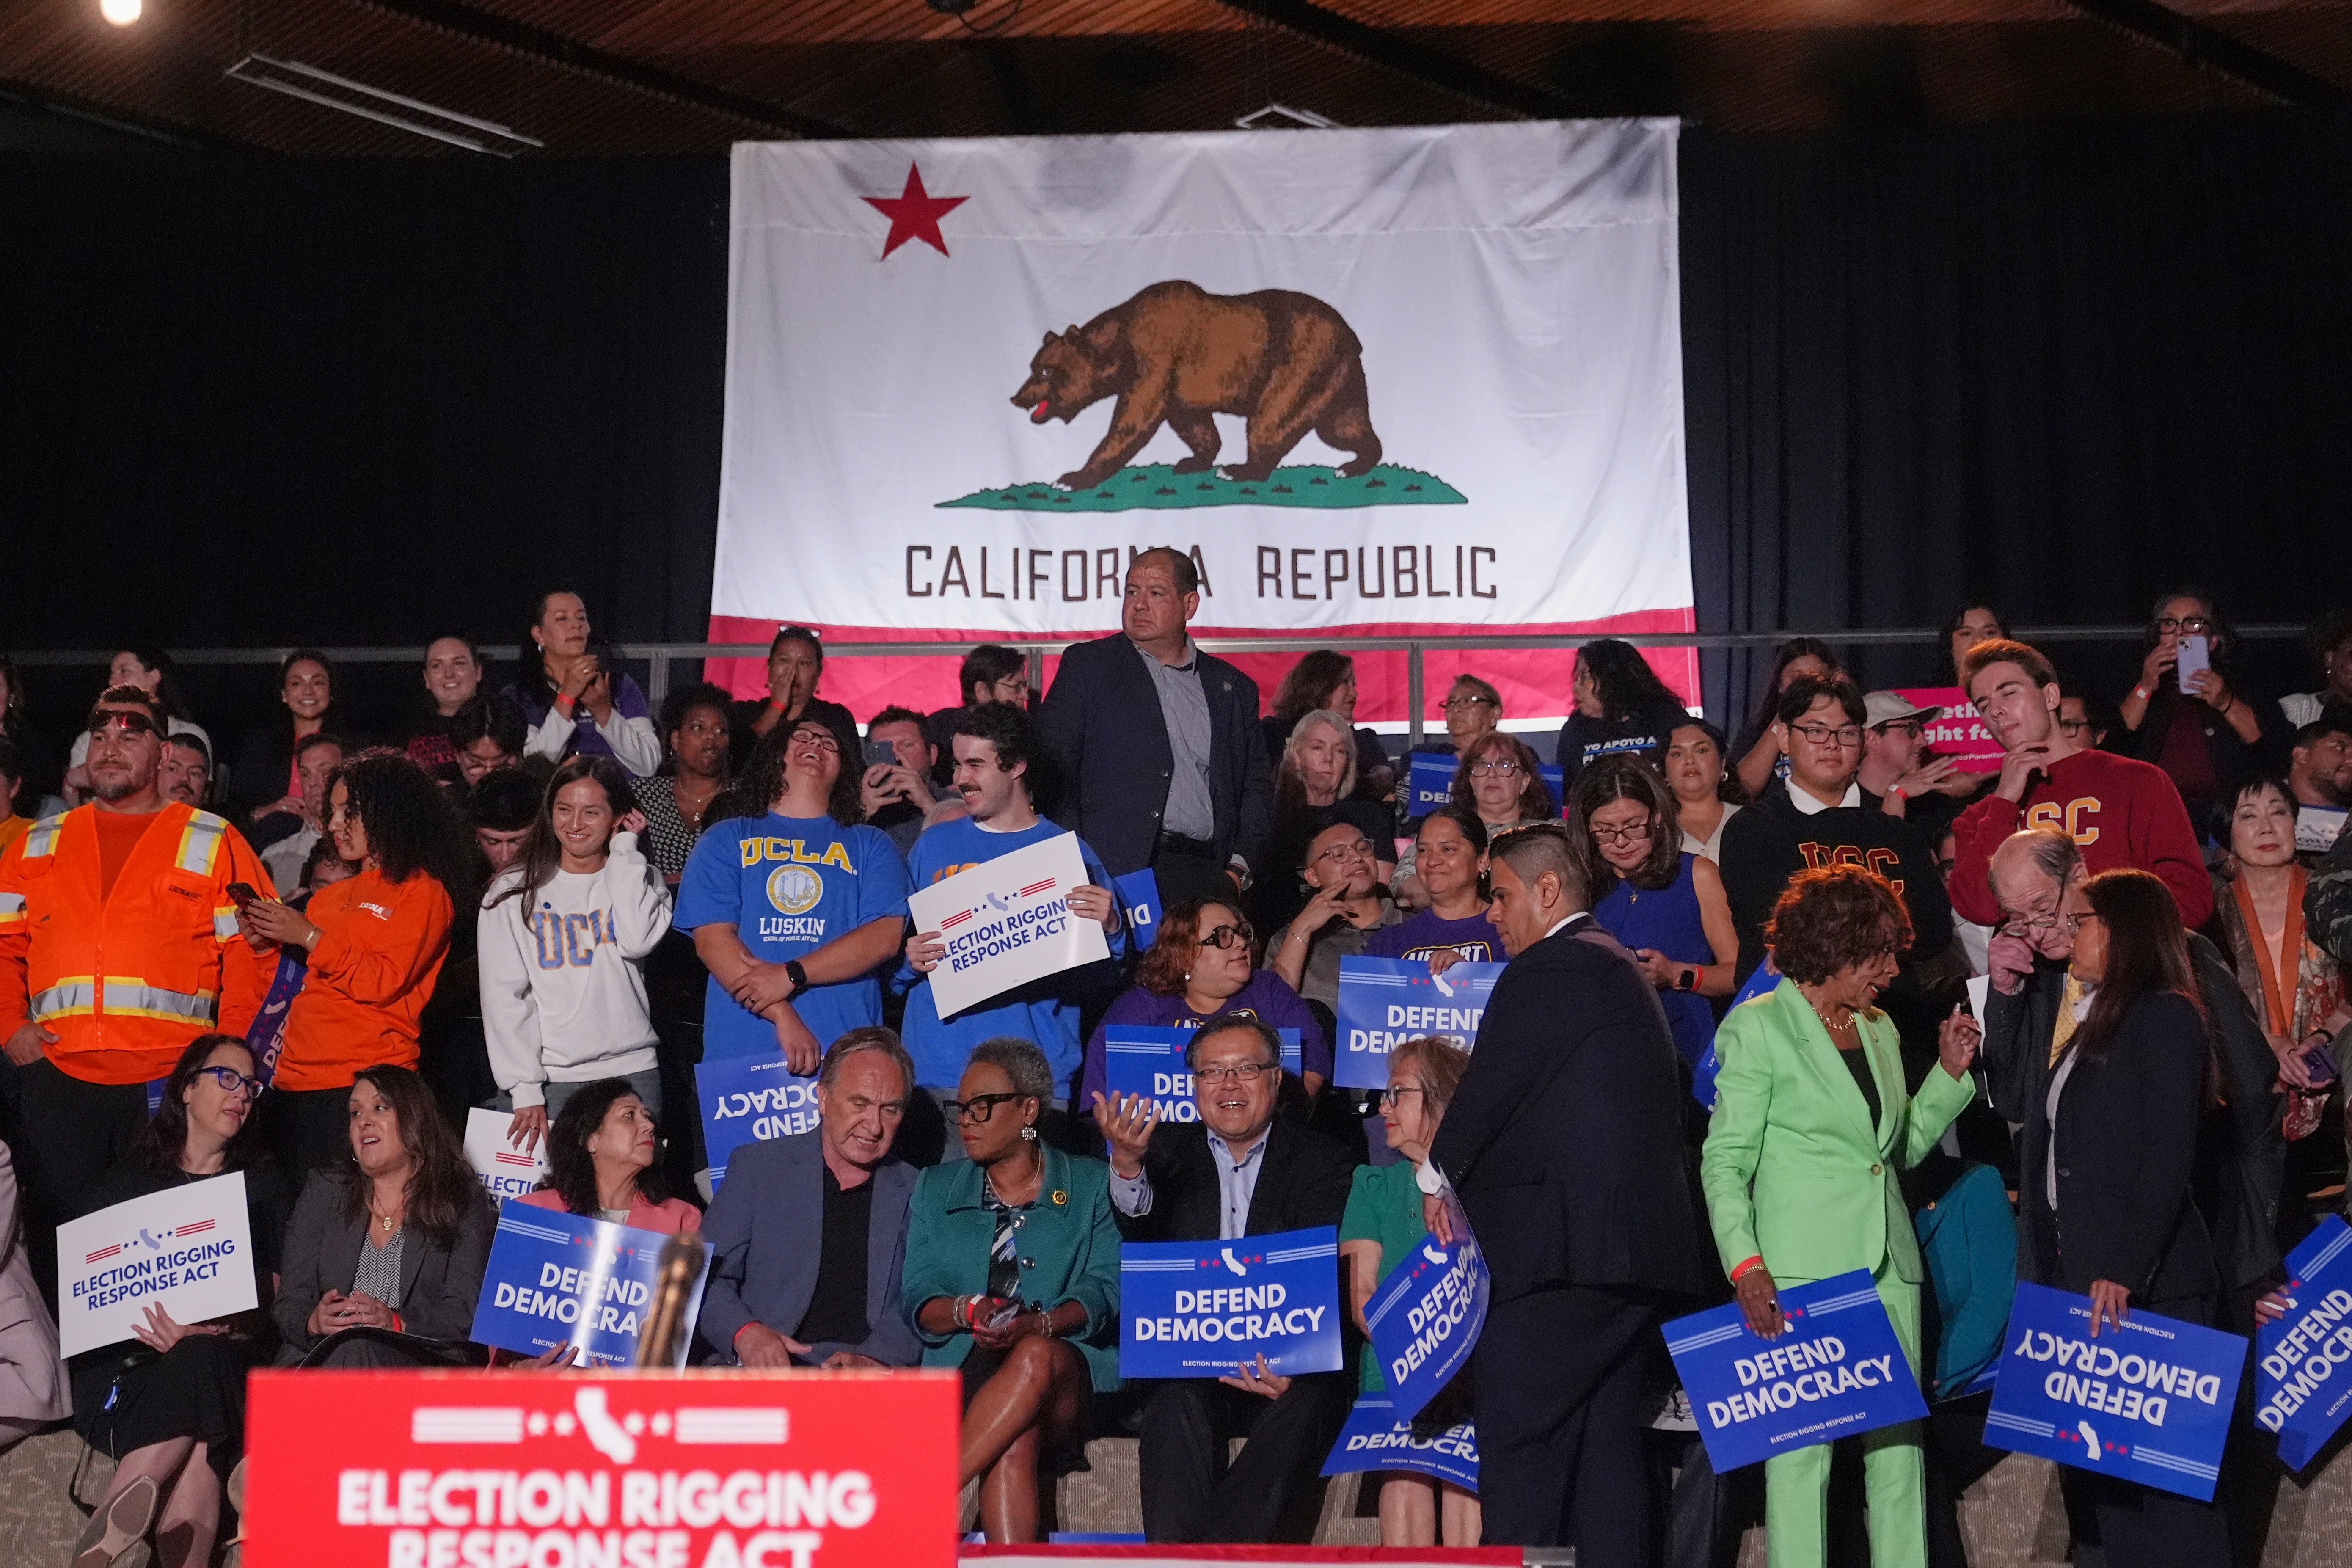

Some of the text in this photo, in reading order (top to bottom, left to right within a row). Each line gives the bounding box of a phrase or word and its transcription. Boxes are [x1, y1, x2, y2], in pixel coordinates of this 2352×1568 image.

[906, 545, 1497, 601] CALIFORA REPUBLIC
[1584, 736, 1657, 752] YO APOYO A
[2017, 796, 2101, 845] SC
[740, 836, 853, 875] UCLA
[759, 917, 826, 936] LUSKIN
[937, 921, 1004, 962] LECTION
[952, 916, 1066, 973] RESPONSE ACT
[713, 1081, 819, 1120] OCRACY
[752, 1109, 821, 1141] FEND
[475, 1173, 540, 1194] LECTI
[73, 1239, 234, 1298] ELECTION RIGGING
[88, 1261, 219, 1311] RESPONSE ACT
[494, 1282, 638, 1337] DEMOCRA
[1176, 1284, 1286, 1314] DEFEND
[1407, 1246, 1467, 1334] DEFEND
[1135, 1306, 1325, 1342] DEMOCRACY
[2119, 1319, 2143, 1331] RIGGIN
[2144, 1326, 2175, 1340] ELECTION
[2260, 1290, 2352, 1382] DEFEND
[587, 1350, 614, 1361] RESPONSE
[1733, 1336, 1846, 1387] DEFEND
[2015, 1329, 2221, 1405] DEMOCRACY
[1707, 1354, 1893, 1429] DEMOCRACY
[2045, 1371, 2167, 1427] DEFEND
[2327, 1390, 2349, 1417] ELECTION
[1346, 1433, 1480, 1463] DEMOCR
[1770, 1412, 1867, 1444] ELECTION RIGGING RESPONSE ACT
[338, 1468, 878, 1528] ELECTION RIGGING
[388, 1528, 822, 1568] RESPONSE ACT
